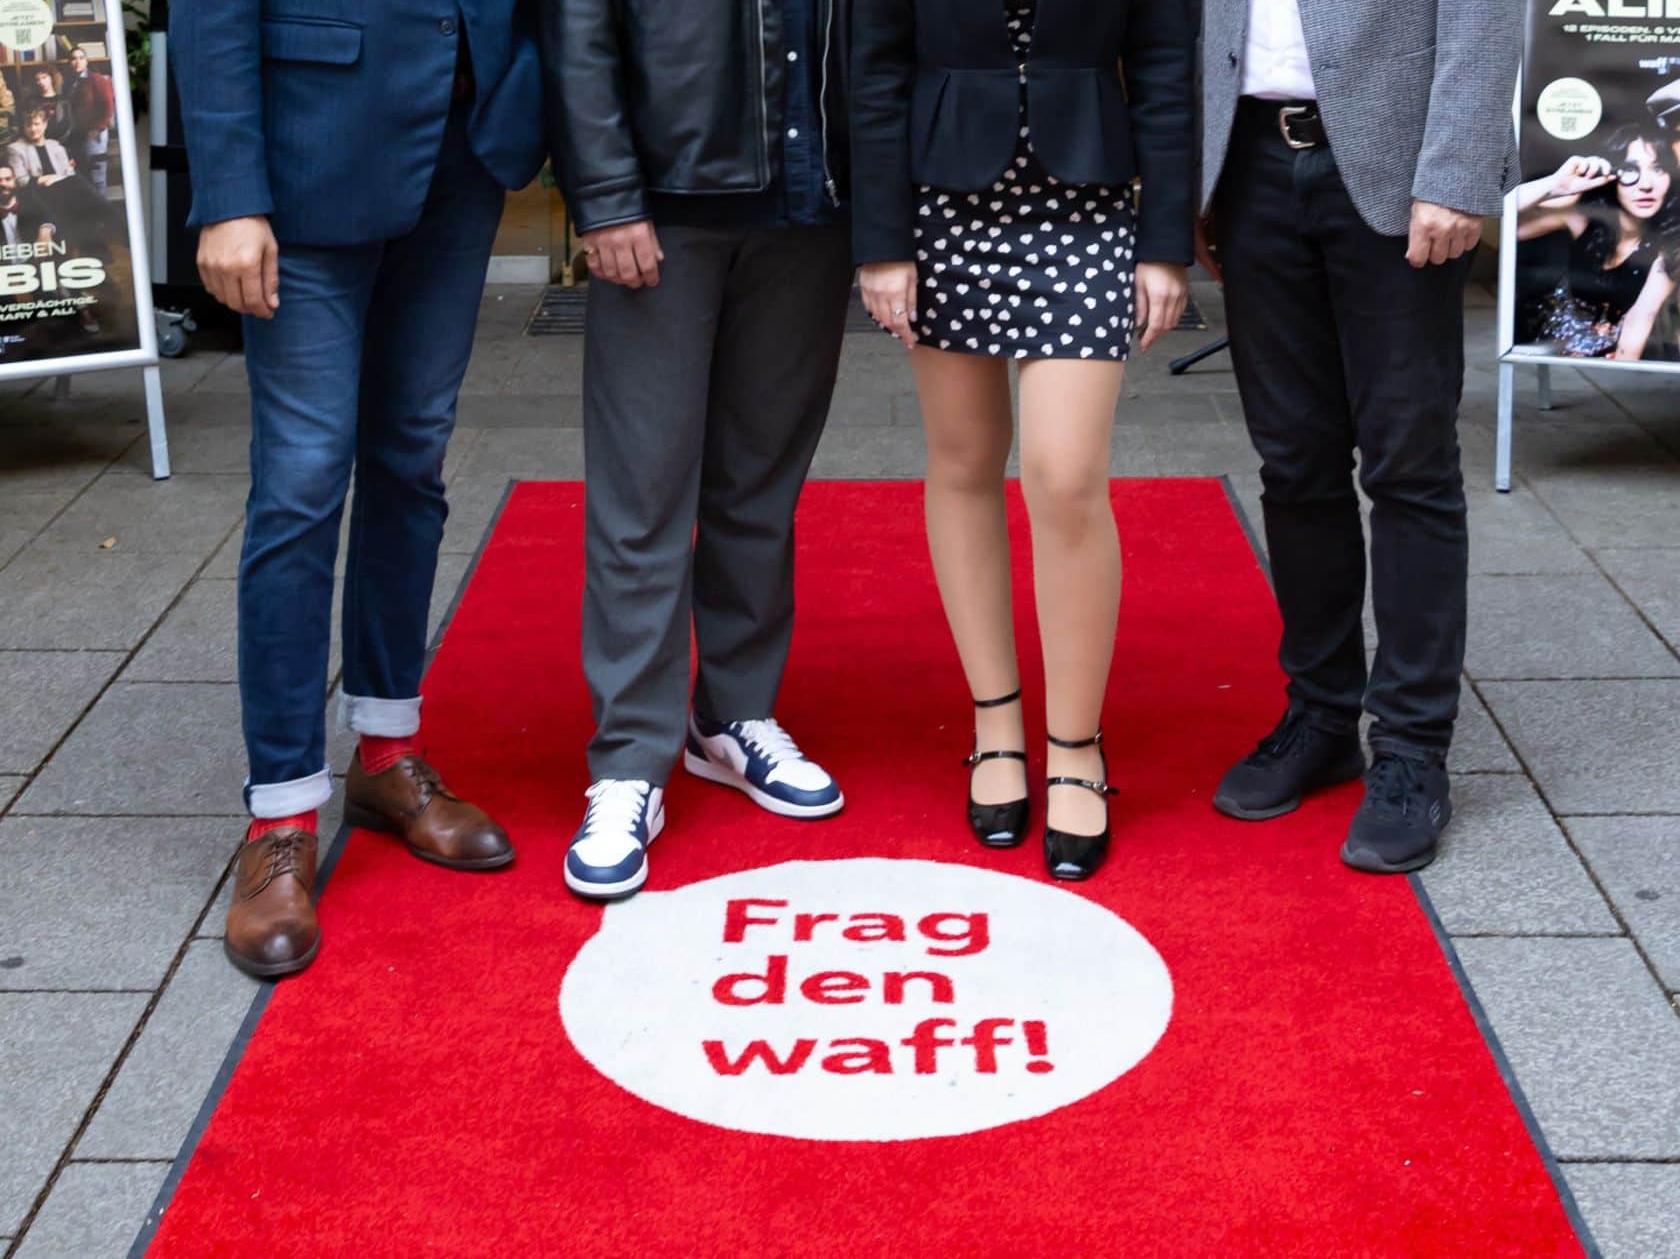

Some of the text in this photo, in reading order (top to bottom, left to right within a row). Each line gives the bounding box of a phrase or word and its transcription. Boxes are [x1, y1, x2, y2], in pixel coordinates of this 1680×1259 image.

[723, 898, 991, 957] Frag
[712, 954, 955, 1007] den
[702, 1016, 1056, 1077] waff!
